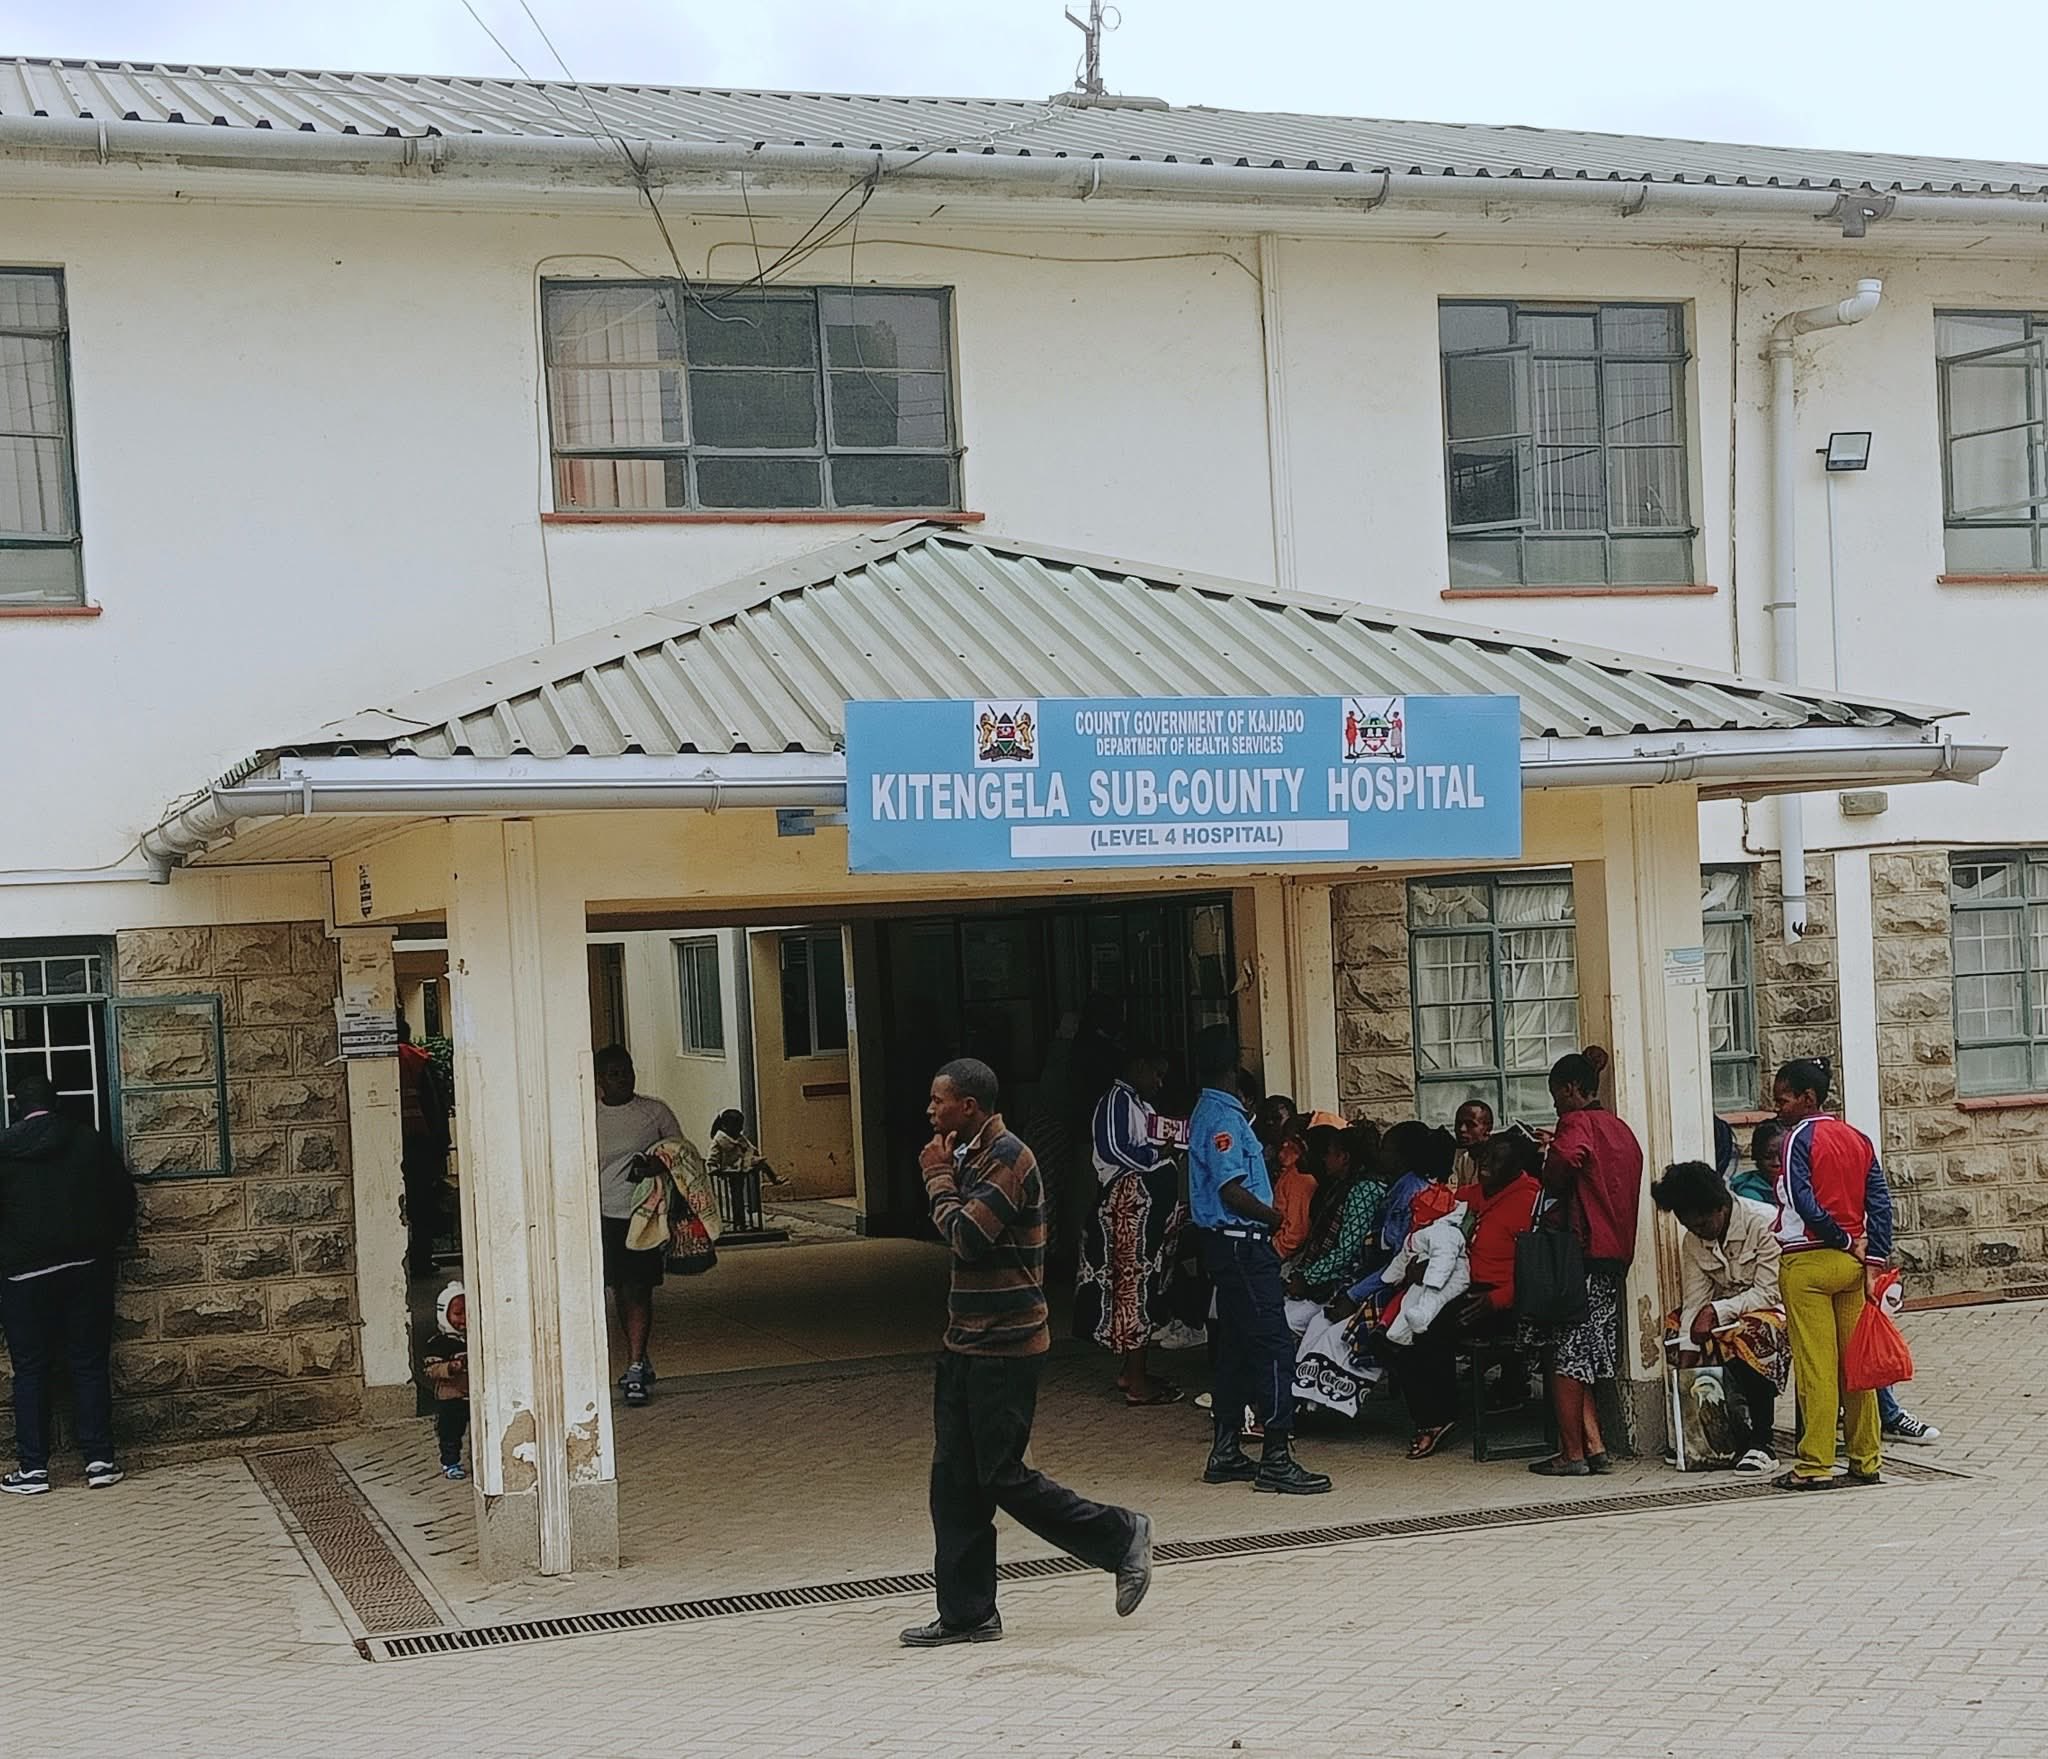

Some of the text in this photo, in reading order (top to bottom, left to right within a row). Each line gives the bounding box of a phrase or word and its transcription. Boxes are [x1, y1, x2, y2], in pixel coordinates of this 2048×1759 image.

[1075, 709, 1304, 735] COUNTY GOVERNMENT OF KAJIADO
[1096, 736, 1284, 756] DEPARTMENT OF HEALTH SERVICES
[871, 764, 1485, 821] KITENGELA SUB-COUNTY HOSPITAL
[1090, 825, 1284, 851] (LEVEL 4 HOSPITAL)
